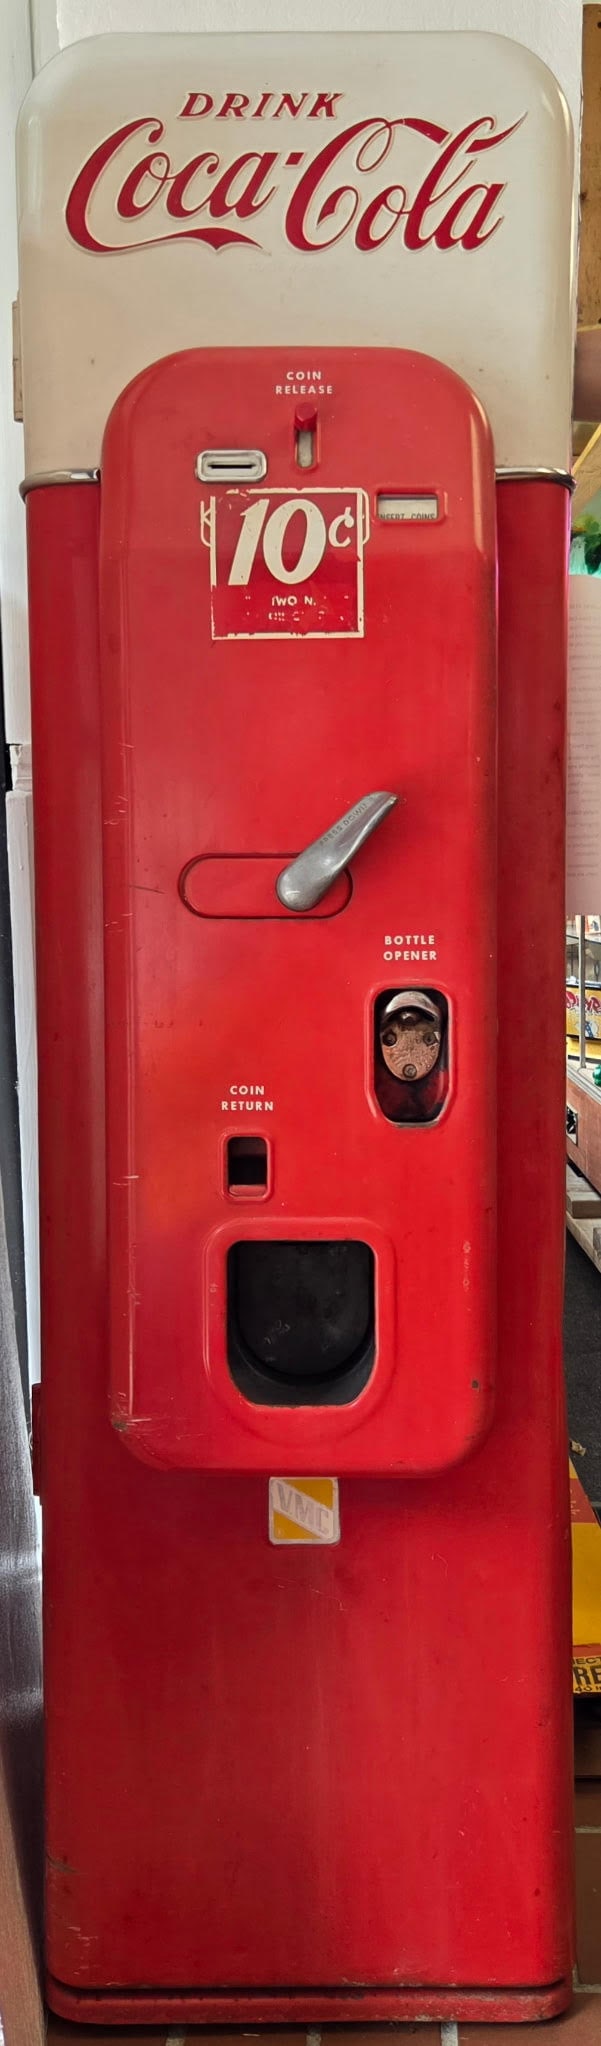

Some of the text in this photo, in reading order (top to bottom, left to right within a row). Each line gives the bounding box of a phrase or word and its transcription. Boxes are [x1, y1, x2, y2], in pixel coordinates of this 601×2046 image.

[179, 92, 343, 118] DRINK
[65, 111, 528, 253] Coca-Cola
[286, 371, 322, 381] COIN
[275, 385, 333, 395] RELEASE
[384, 935, 435, 945] BOTTLE
[383, 951, 437, 961] OPENER
[229, 1085, 265, 1095] COIN
[221, 1101, 274, 1111] RETURN
[275, 1481, 330, 1536] VMC
